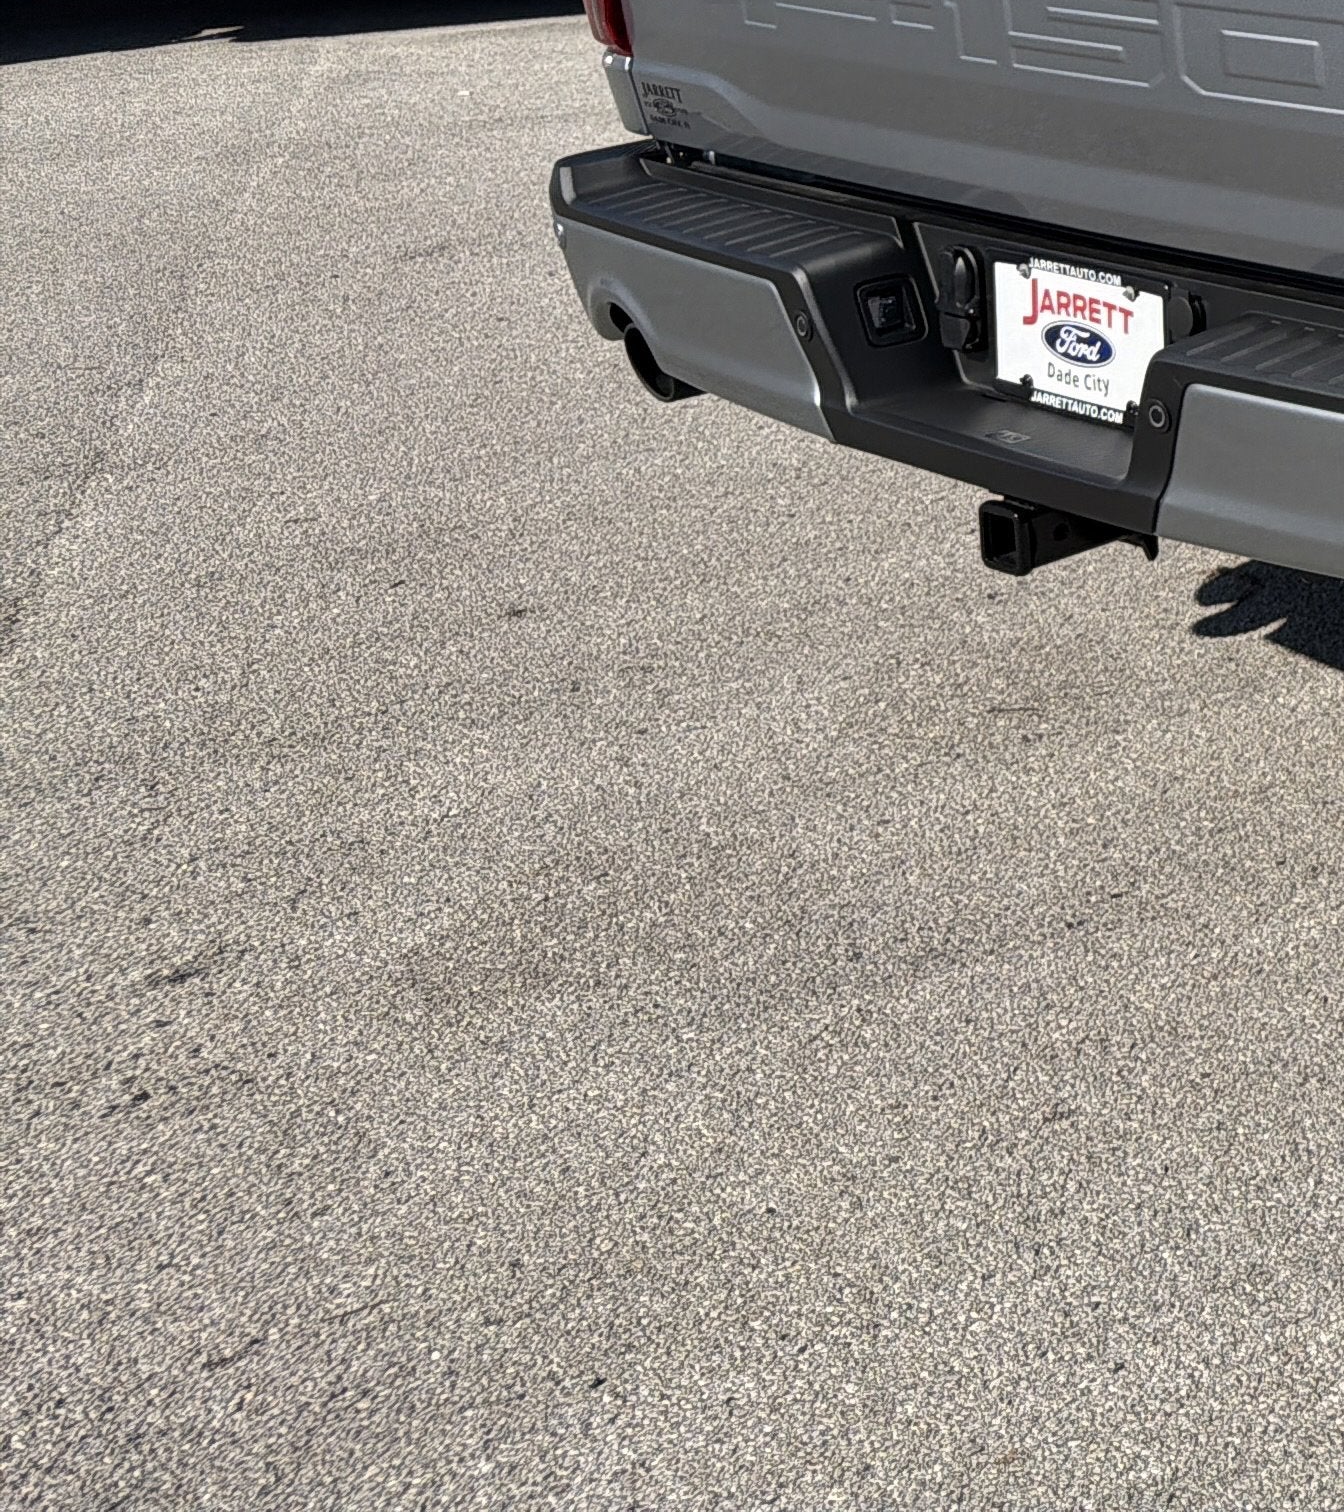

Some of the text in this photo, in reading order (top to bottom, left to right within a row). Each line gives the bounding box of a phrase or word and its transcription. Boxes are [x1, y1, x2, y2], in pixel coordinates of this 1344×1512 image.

[641, 81, 683, 104] JARRETT
[1028, 257, 1122, 286] JARRETTAUTO.COM
[1022, 278, 1134, 335] JARRETT
[1055, 326, 1102, 362] Ford
[1047, 362, 1110, 397] Dade City
[1031, 390, 1123, 424] JARRETTAUTO.COM
